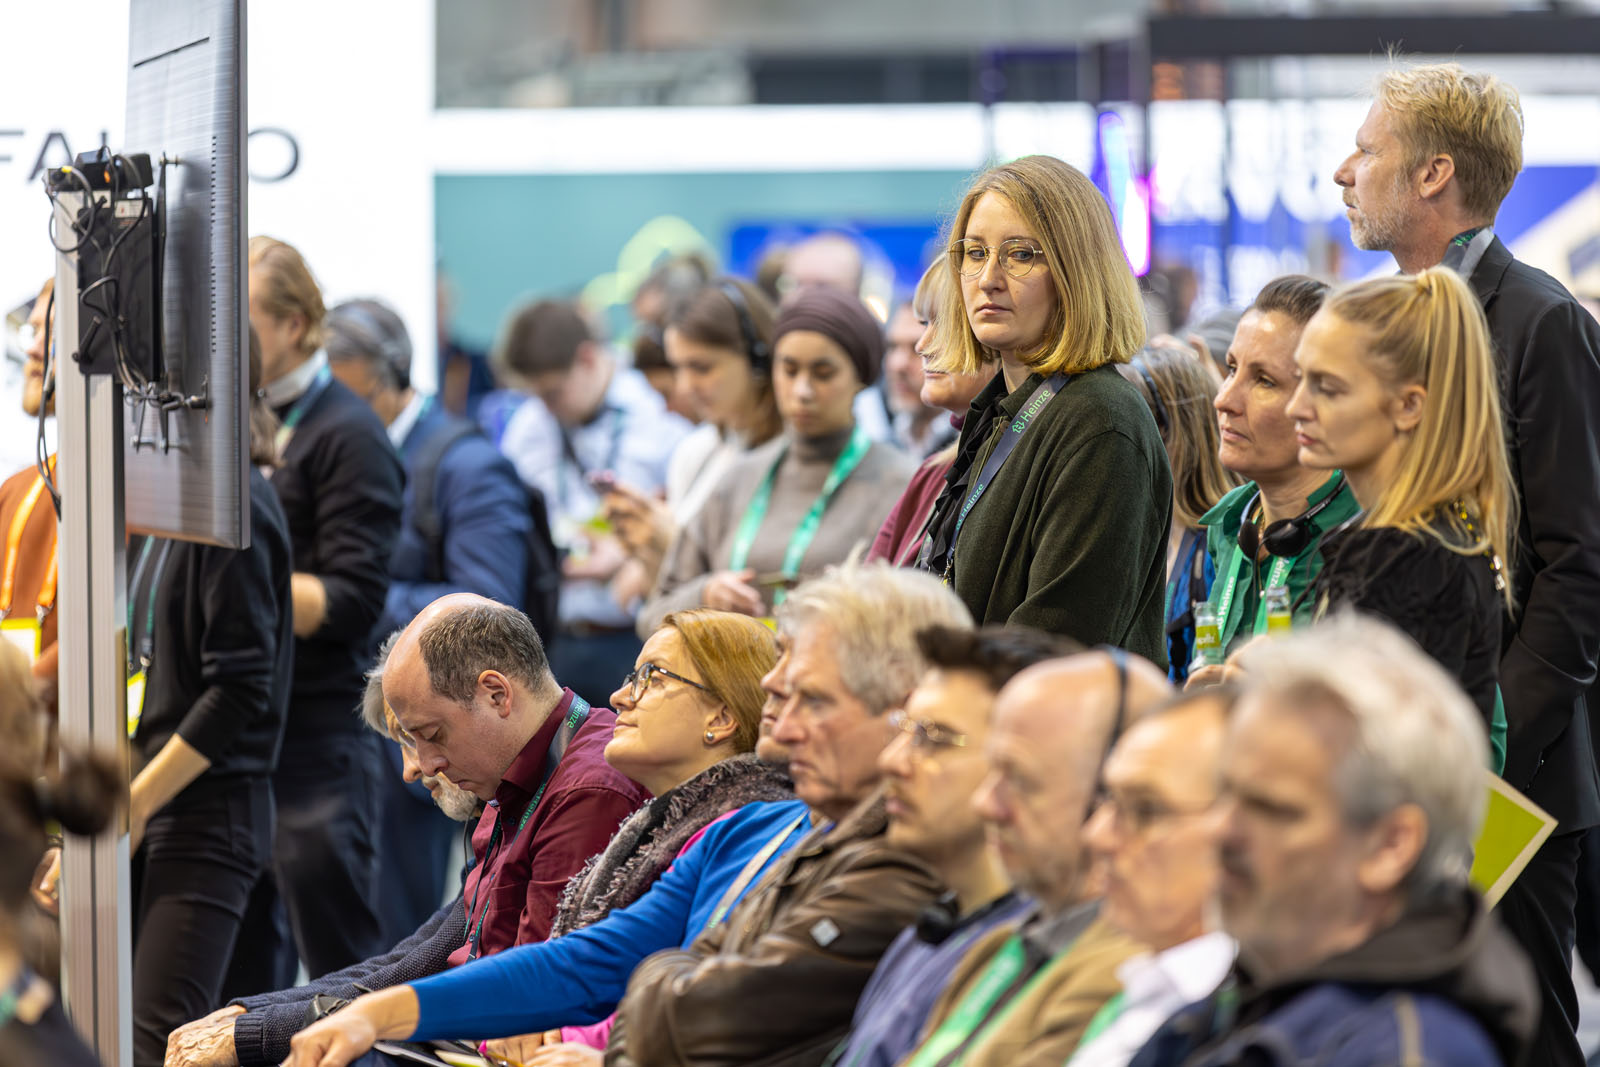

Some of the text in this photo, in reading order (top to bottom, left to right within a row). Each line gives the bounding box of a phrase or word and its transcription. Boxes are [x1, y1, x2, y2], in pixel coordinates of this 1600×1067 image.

[1022, 389, 1051, 422] Heinze
[961, 483, 984, 517] Heinze
[566, 700, 587, 728] Heinze
